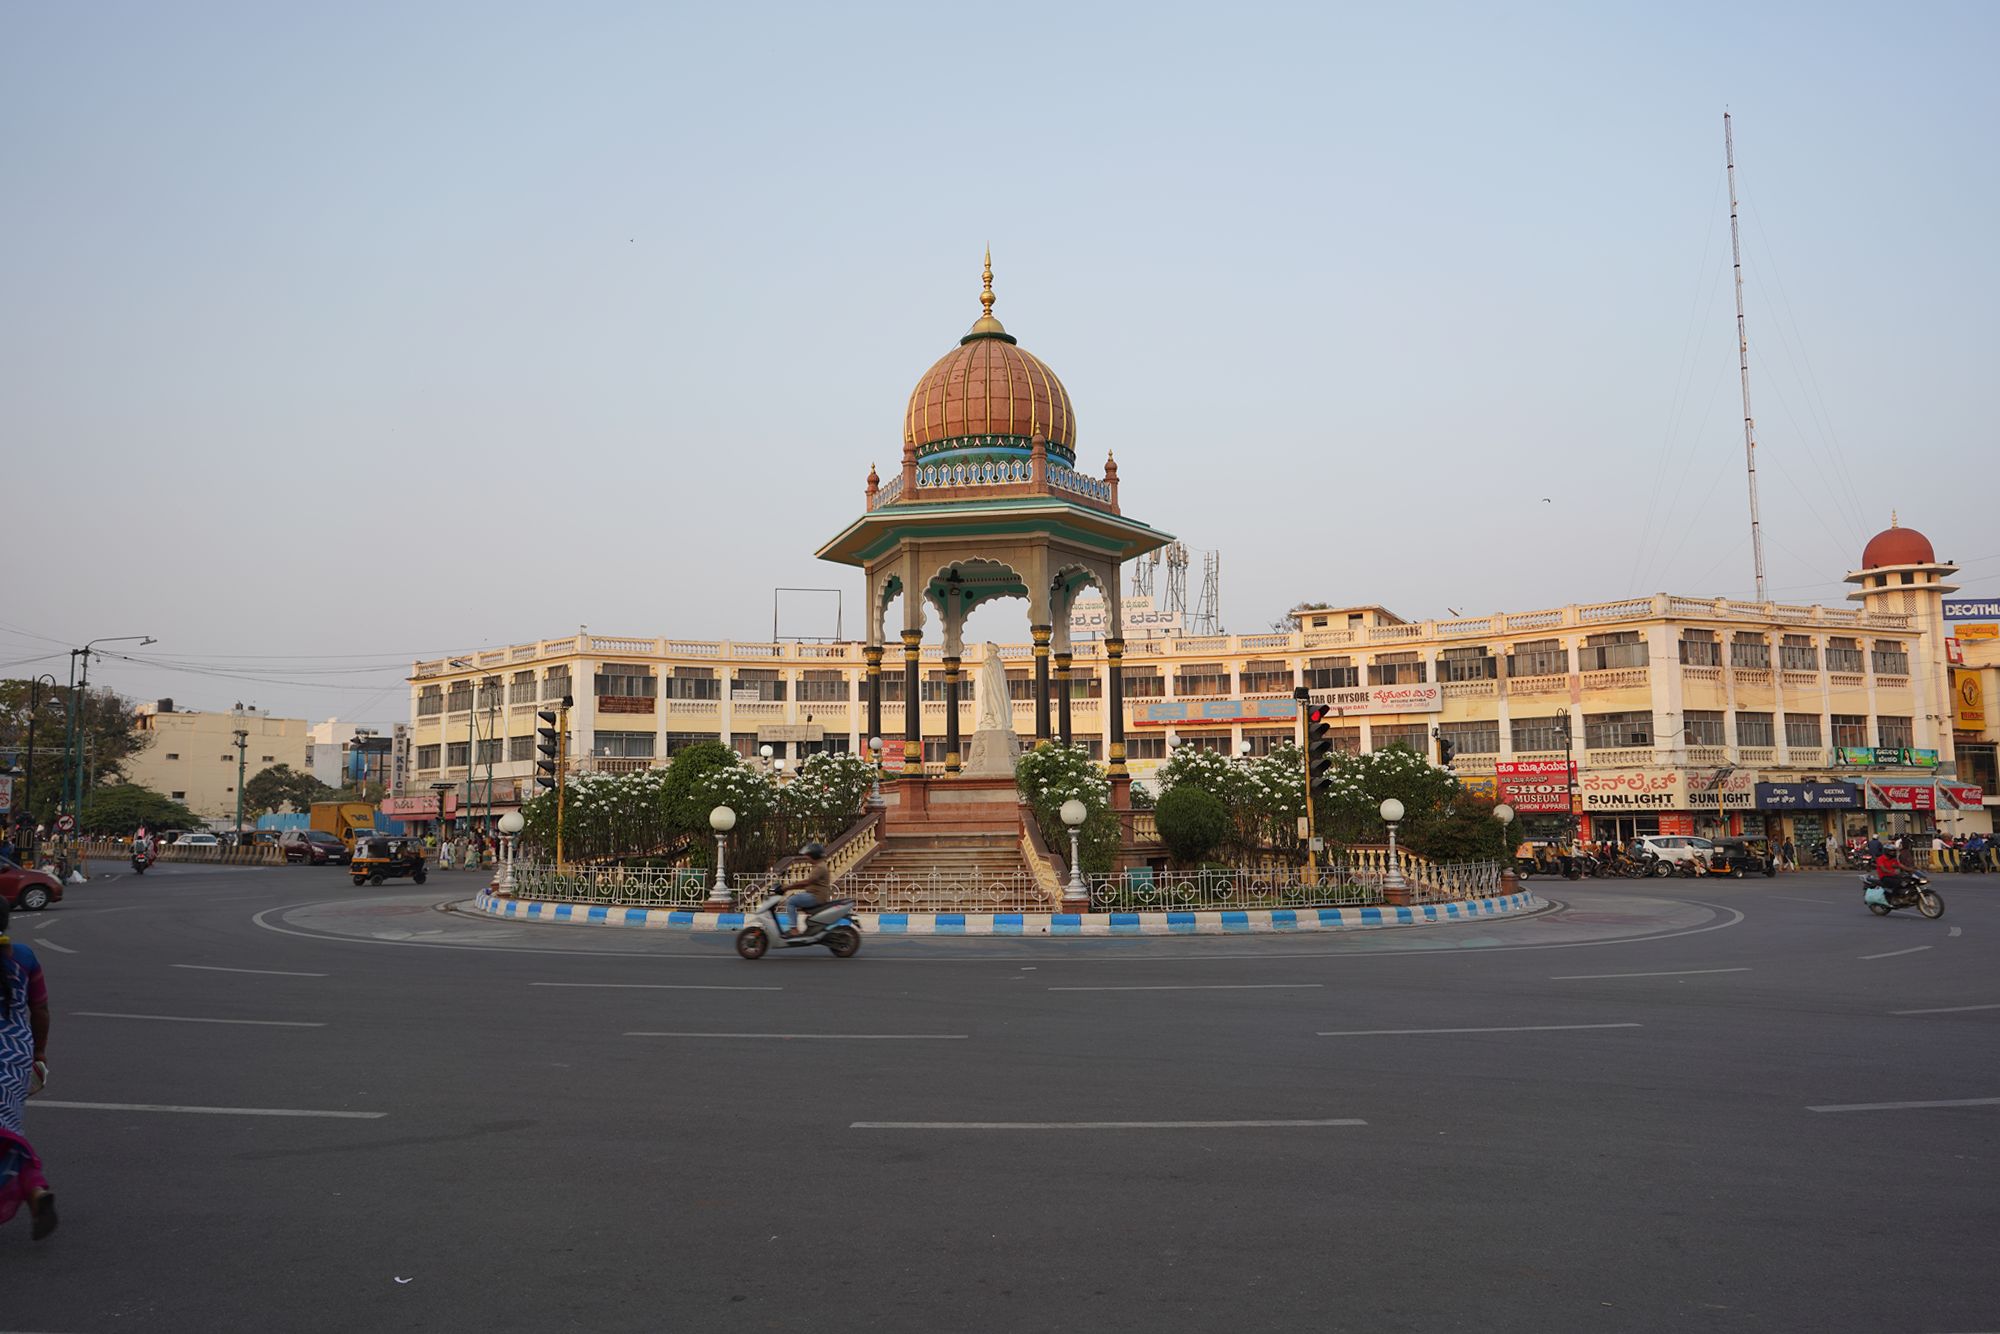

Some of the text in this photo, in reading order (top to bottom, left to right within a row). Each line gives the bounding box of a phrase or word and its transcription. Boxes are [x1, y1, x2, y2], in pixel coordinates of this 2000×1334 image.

[1130, 610, 1174, 625] ಭವನ
[1309, 692, 1370, 704] TAR OF MYSORE
[1506, 785, 1568, 794] SHOE
[1514, 794, 1559, 803] MUSEUM
[1588, 794, 1674, 804] SUNLIGHT
